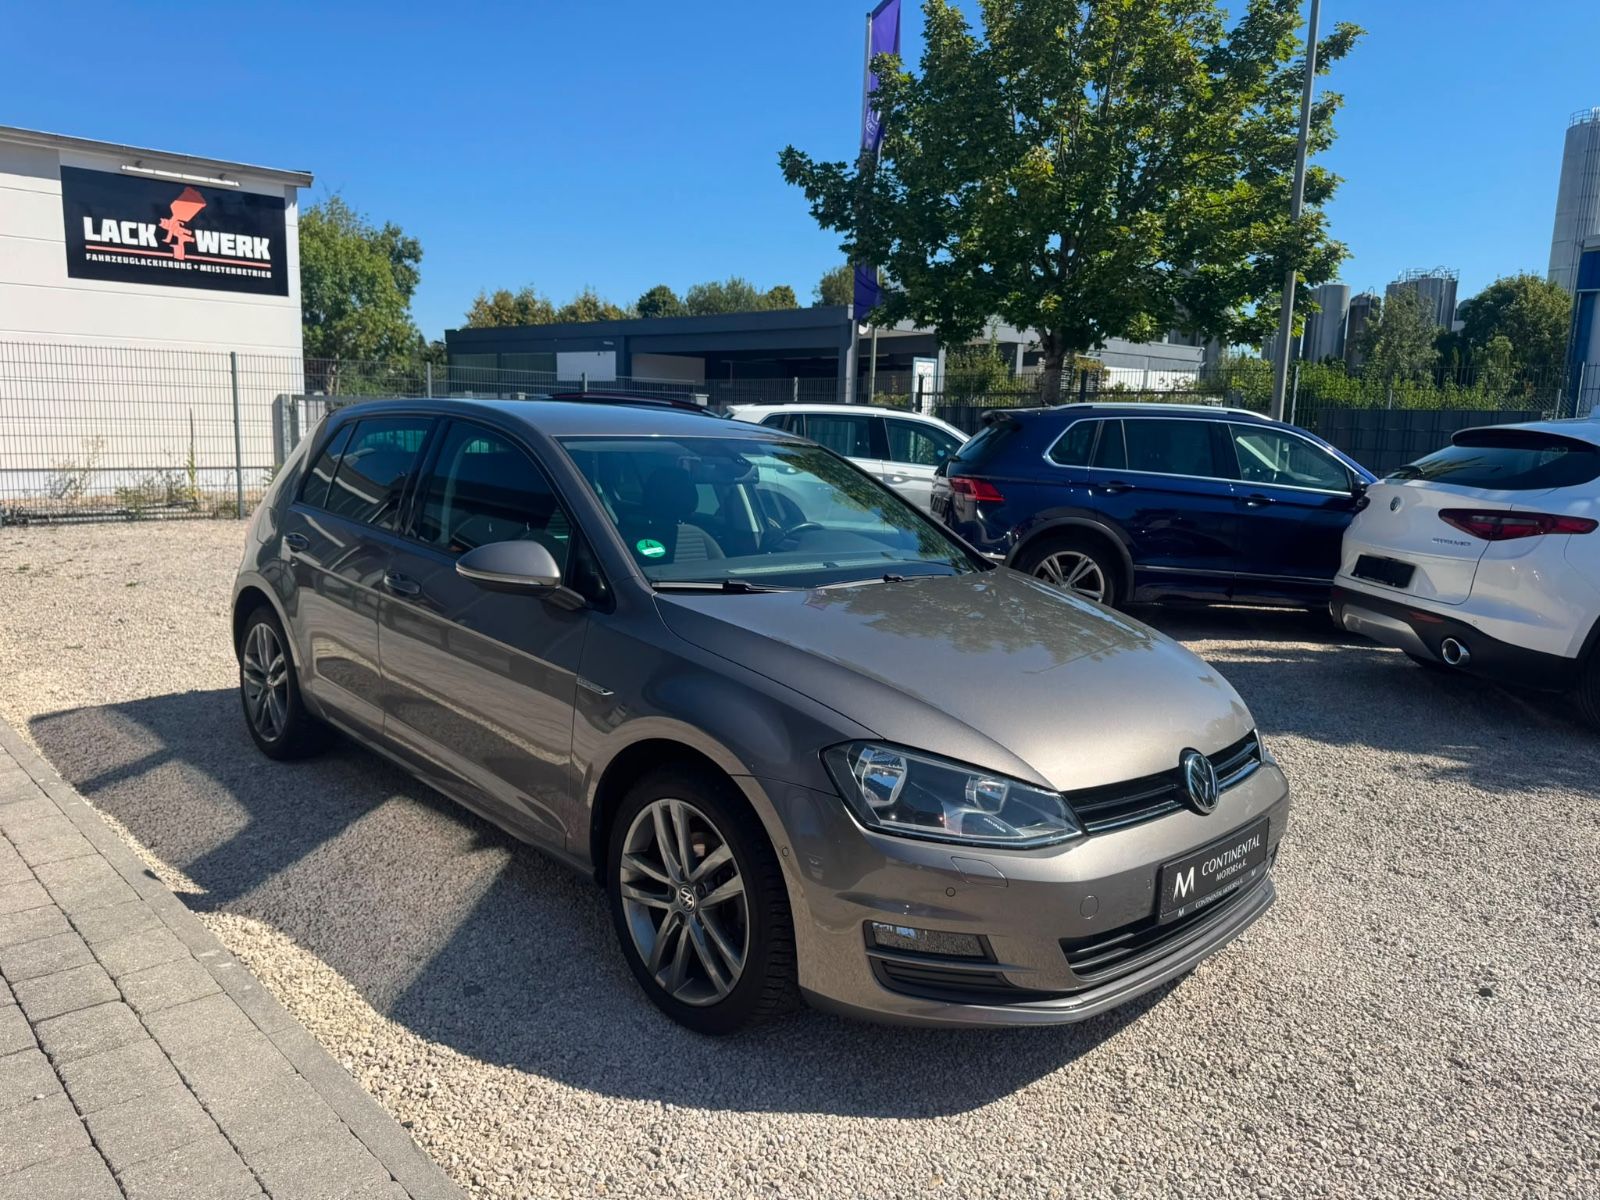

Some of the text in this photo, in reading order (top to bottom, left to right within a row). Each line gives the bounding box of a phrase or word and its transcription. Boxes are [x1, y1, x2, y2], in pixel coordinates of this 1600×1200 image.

[83, 216, 270, 260] LACK WERK
[86, 253, 272, 278] FAHRZEUGLACKIERUNG MEISTERBETRIEB
[1173, 834, 1260, 902] M CONTINENTAL
[1216, 862, 1238, 881] MOTORS
